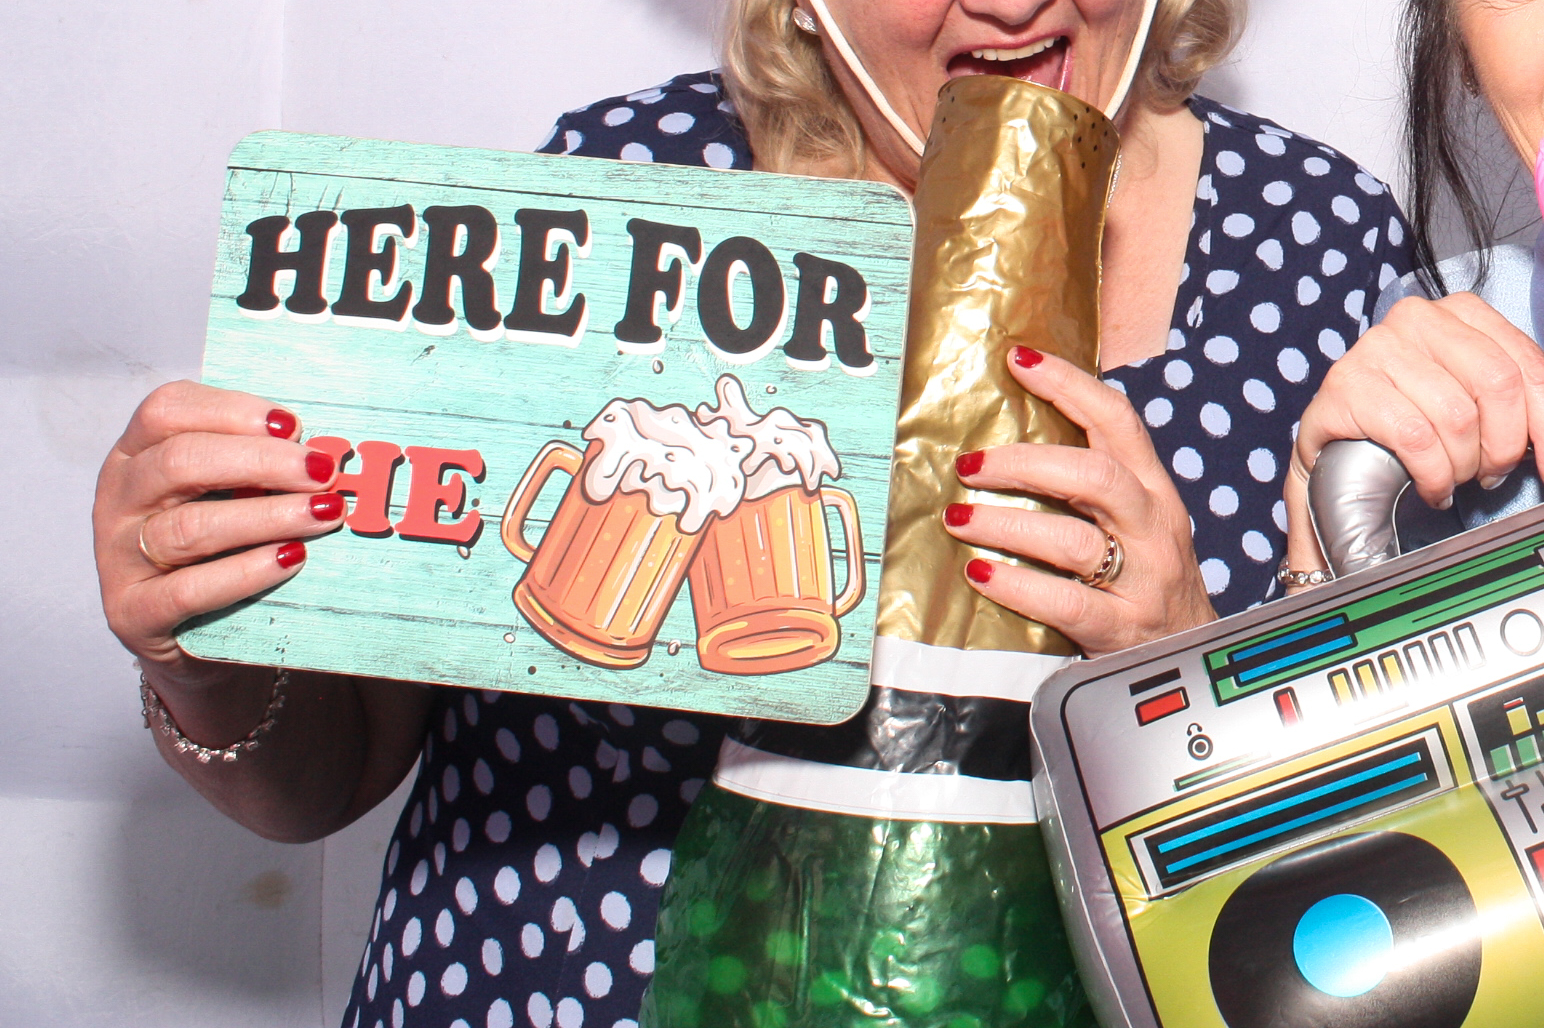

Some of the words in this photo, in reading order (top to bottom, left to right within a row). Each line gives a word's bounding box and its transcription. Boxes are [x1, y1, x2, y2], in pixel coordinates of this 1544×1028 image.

[236, 203, 591, 346] HERE
[614, 218, 877, 374] FOR
[232, 436, 486, 548] HE
